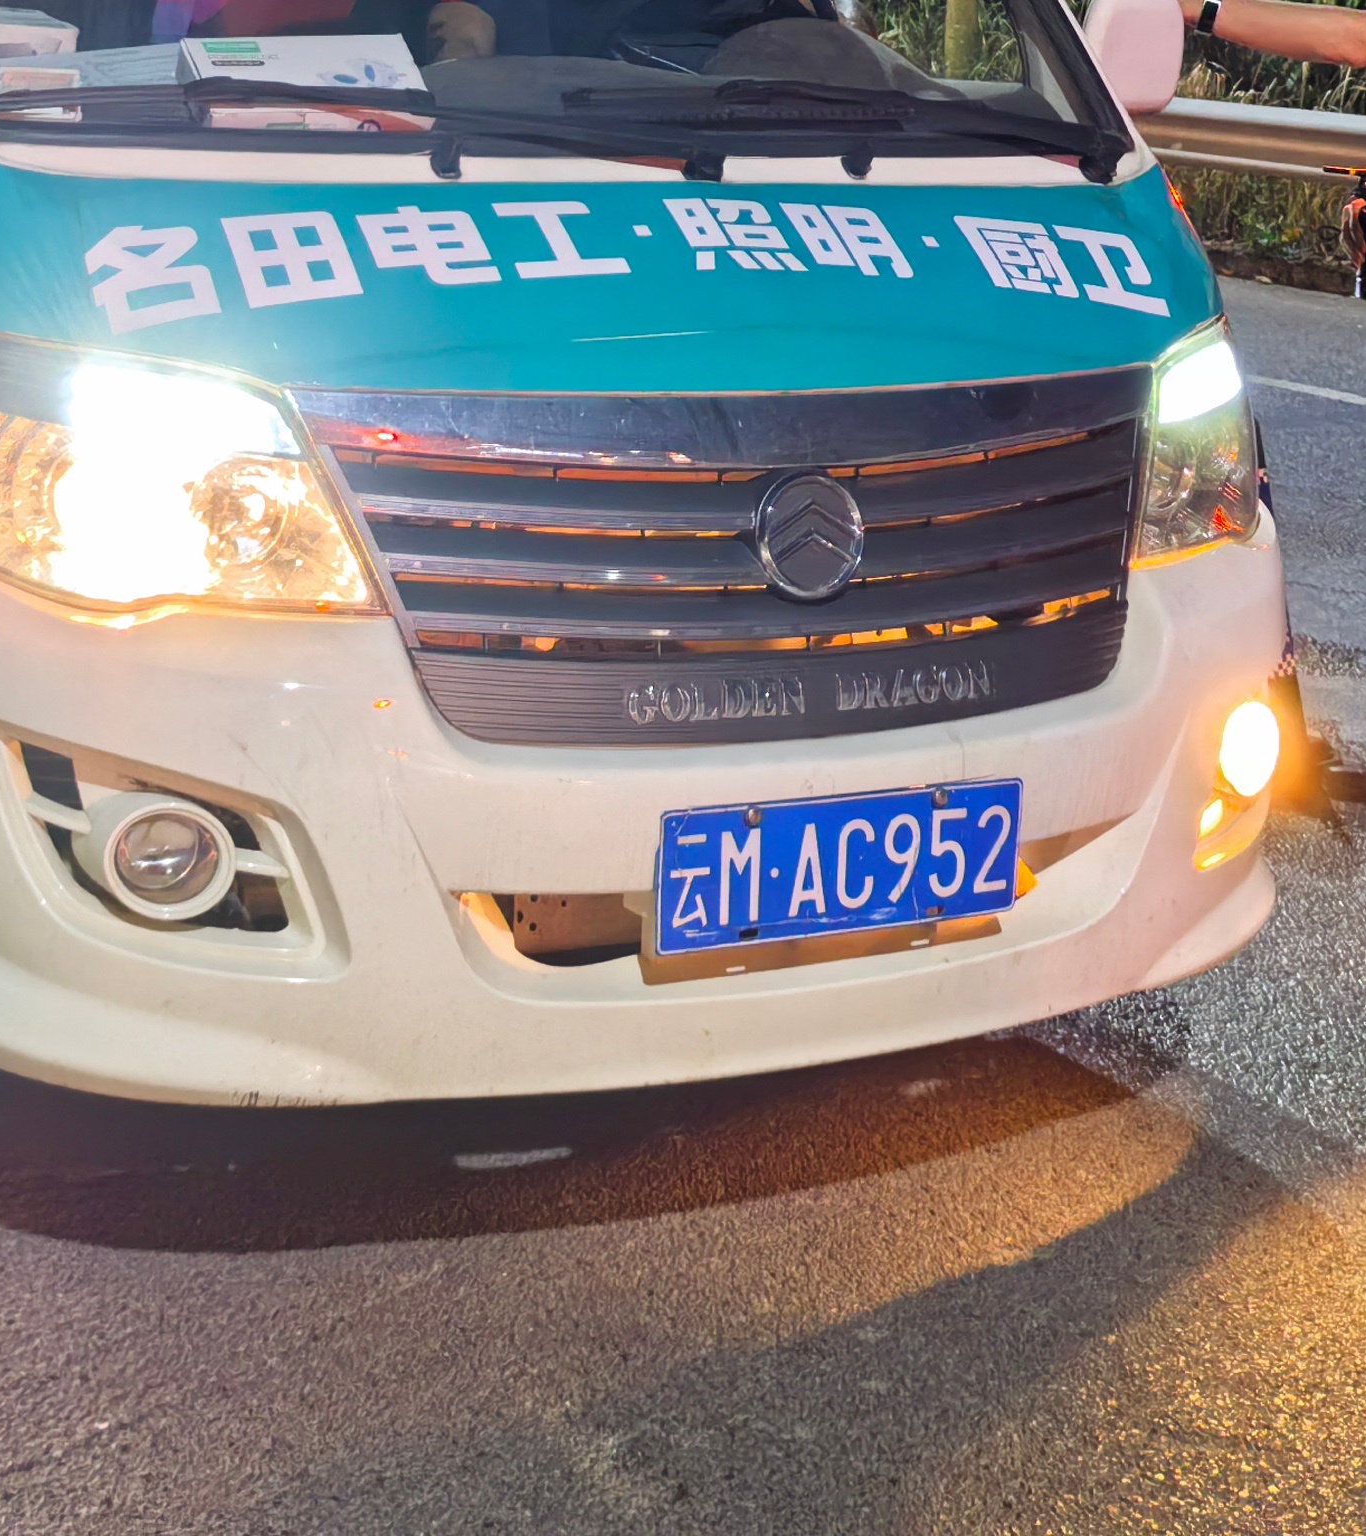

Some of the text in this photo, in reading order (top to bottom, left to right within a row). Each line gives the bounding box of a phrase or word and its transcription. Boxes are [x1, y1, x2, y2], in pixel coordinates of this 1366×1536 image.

[85, 198, 1171, 335] 名田电工·照明·厨卫
[628, 662, 994, 725] GOLDEN DRAGON
